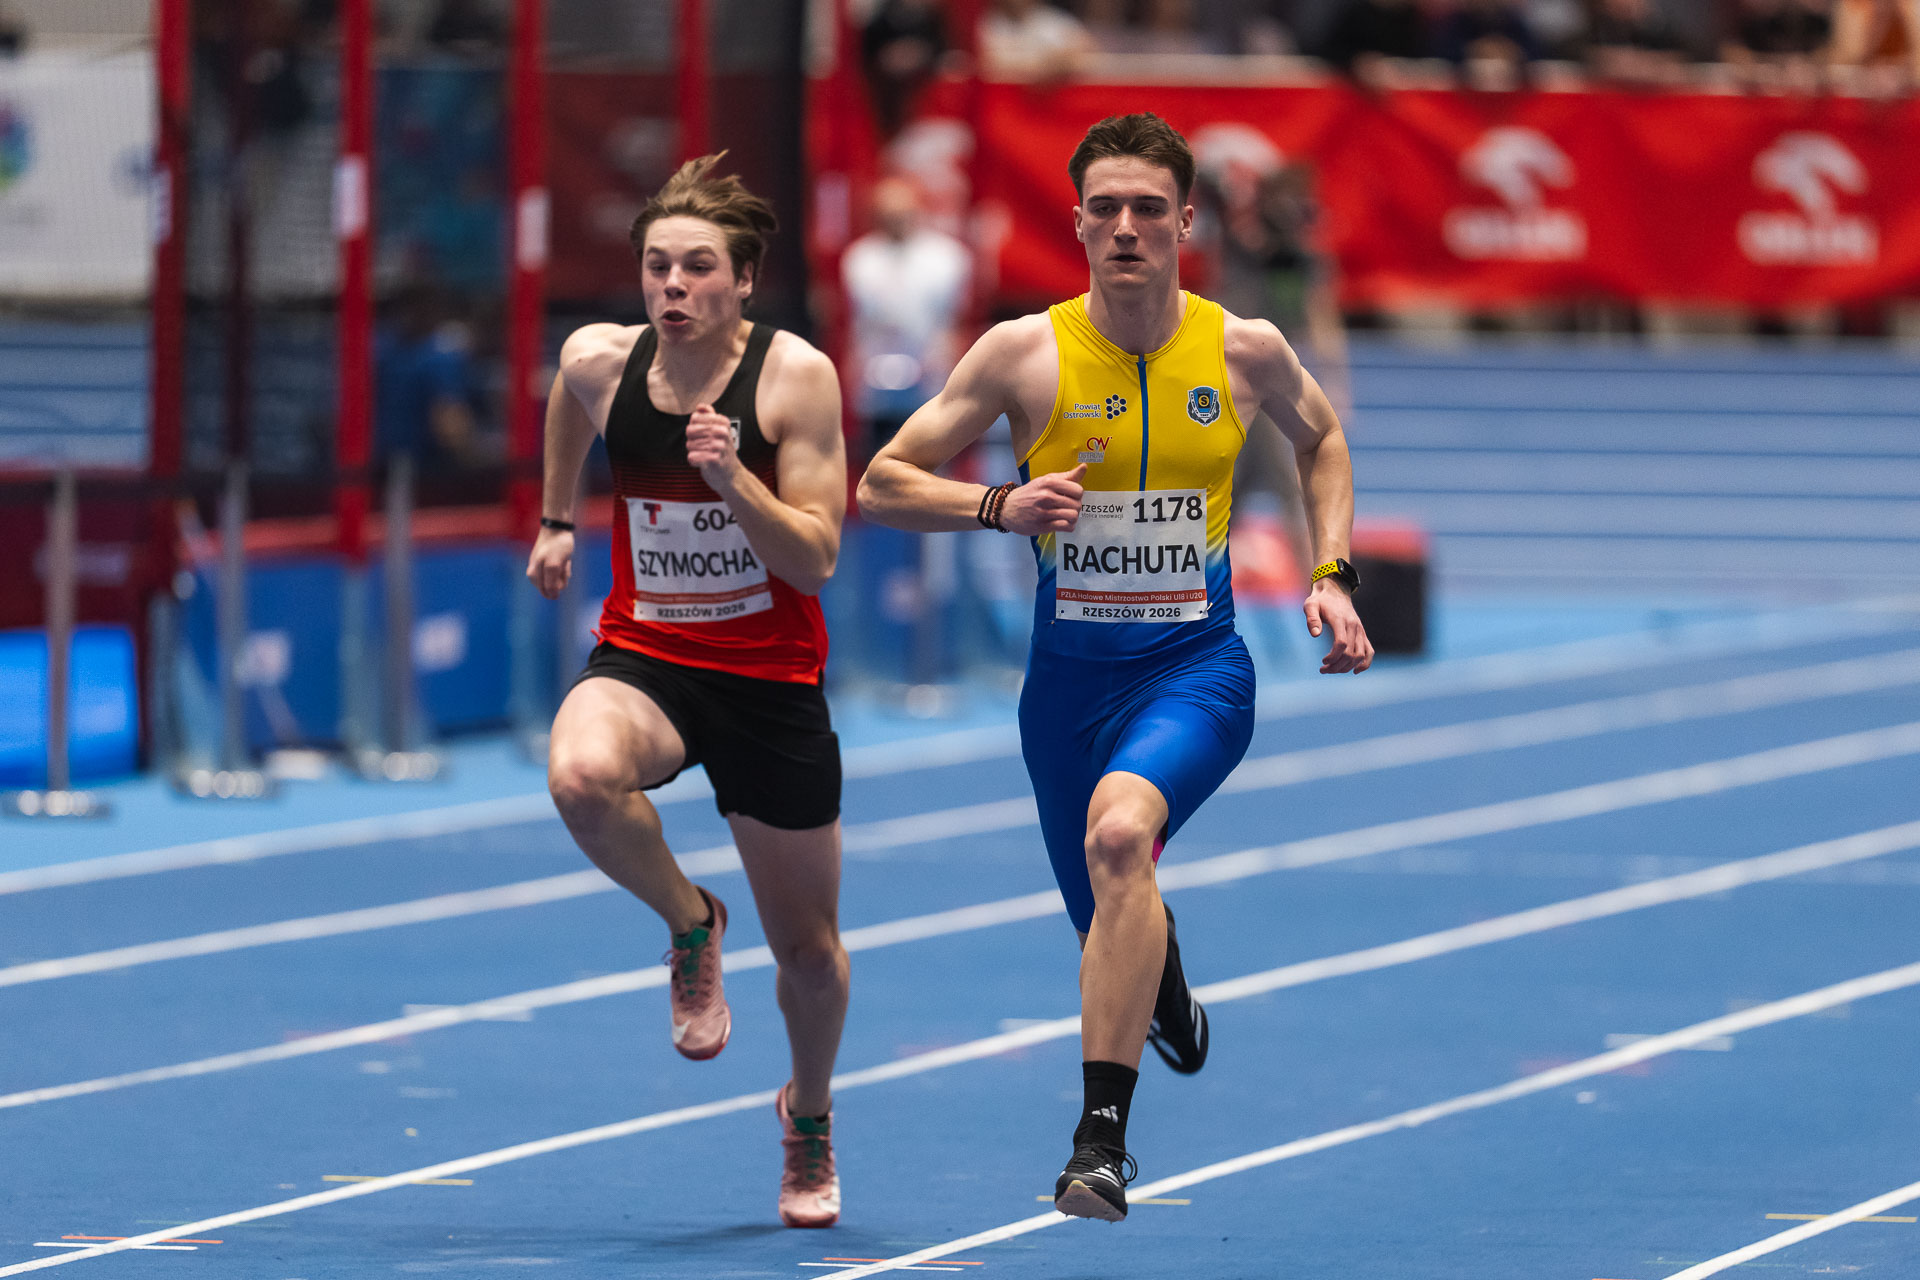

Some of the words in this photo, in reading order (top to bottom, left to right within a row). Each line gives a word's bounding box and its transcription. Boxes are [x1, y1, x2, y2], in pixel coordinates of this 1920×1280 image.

[1074, 403, 1101, 411] Powiat
[1063, 411, 1102, 419] Ostrowski
[1081, 503, 1124, 513] rzeszów
[1133, 496, 1203, 523] 1178
[638, 548, 758, 577] SZYMOCHA
[1063, 543, 1200, 574] RACHUTA
[1078, 592, 1103, 601] Halowe
[1105, 592, 1149, 602] Mistrzostwa
[1150, 592, 1172, 601] Polski
[1190, 591, 1203, 600] U20
[657, 606, 713, 618] RZESZÓW
[716, 602, 746, 616] 2026
[1082, 606, 1147, 618] RZESZÓW
[1149, 607, 1181, 617] 2026
